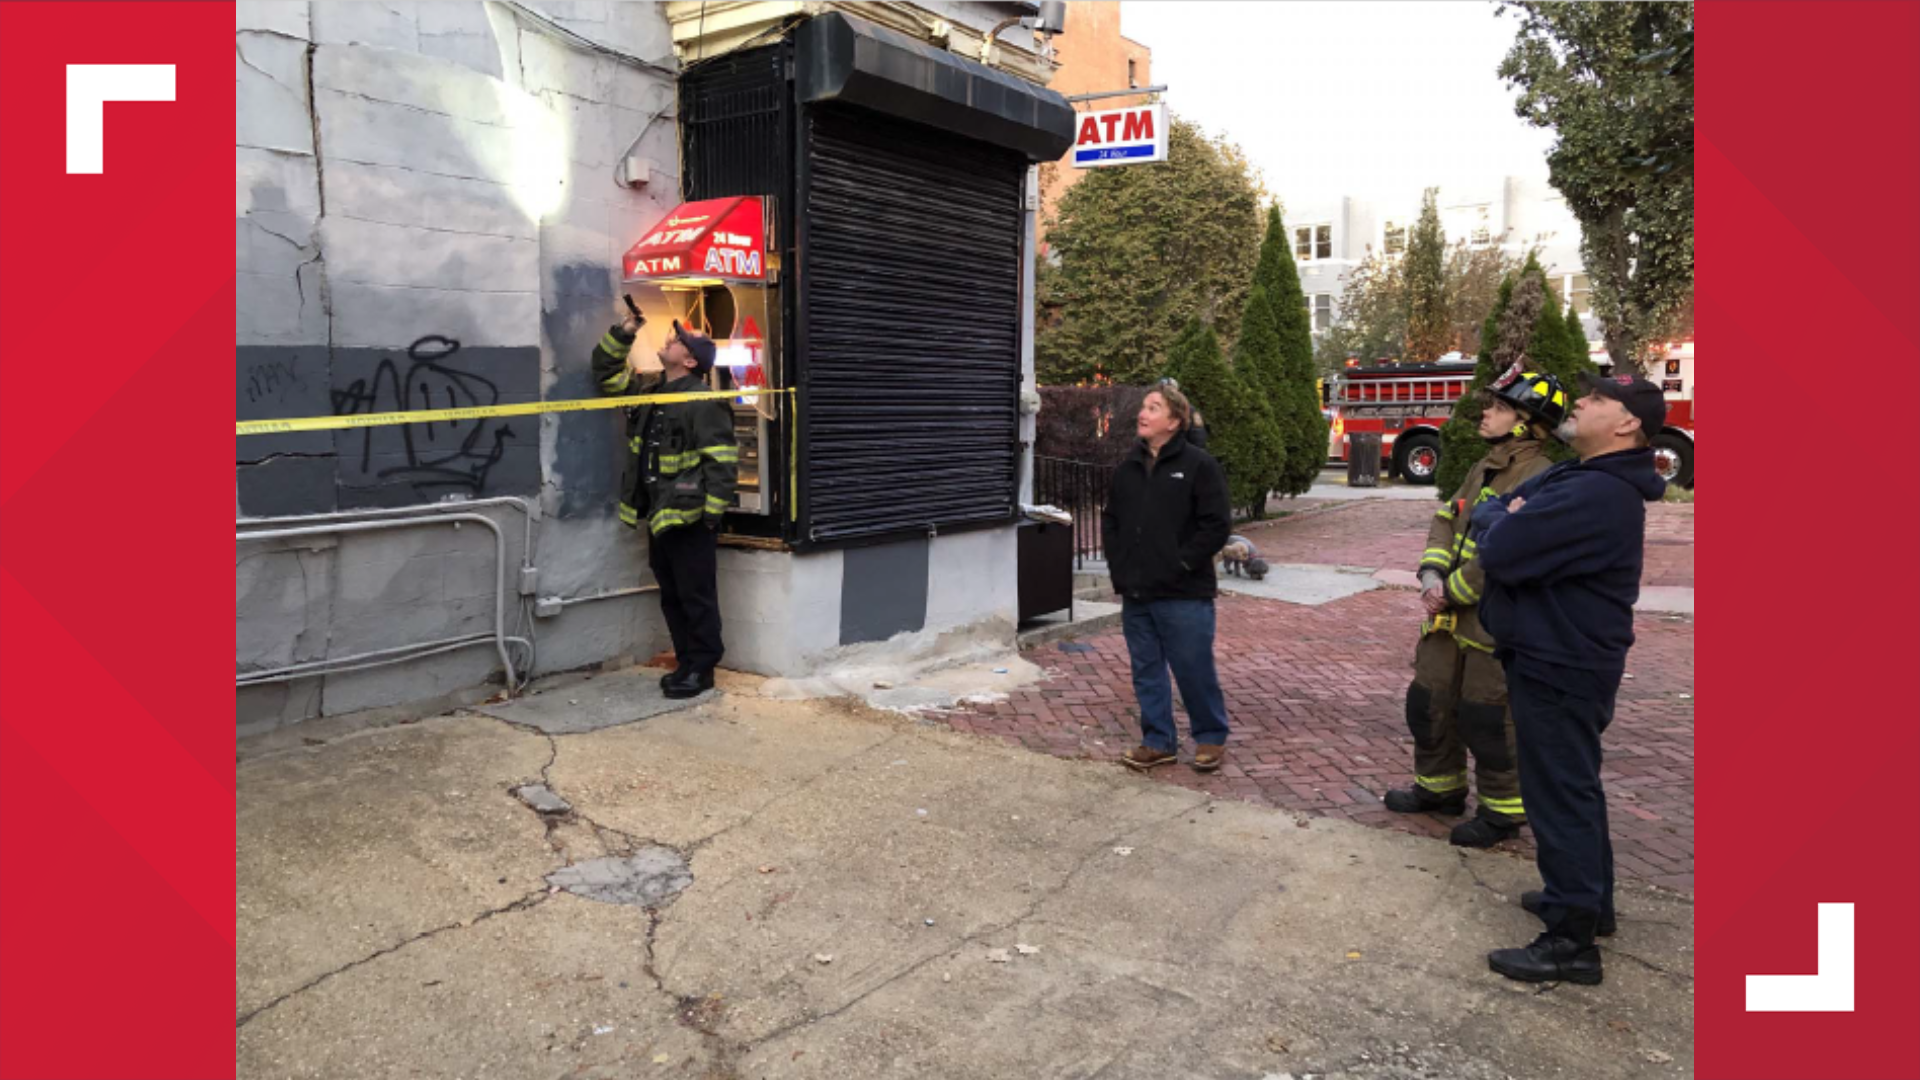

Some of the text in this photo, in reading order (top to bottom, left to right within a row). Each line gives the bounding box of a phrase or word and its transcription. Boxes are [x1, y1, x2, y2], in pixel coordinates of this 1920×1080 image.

[1077, 109, 1154, 145] ATM
[638, 226, 706, 248] ATM
[713, 231, 726, 244] 24
[634, 256, 681, 274] ATM
[704, 247, 761, 275] ATM
[742, 314, 767, 386] ATM
